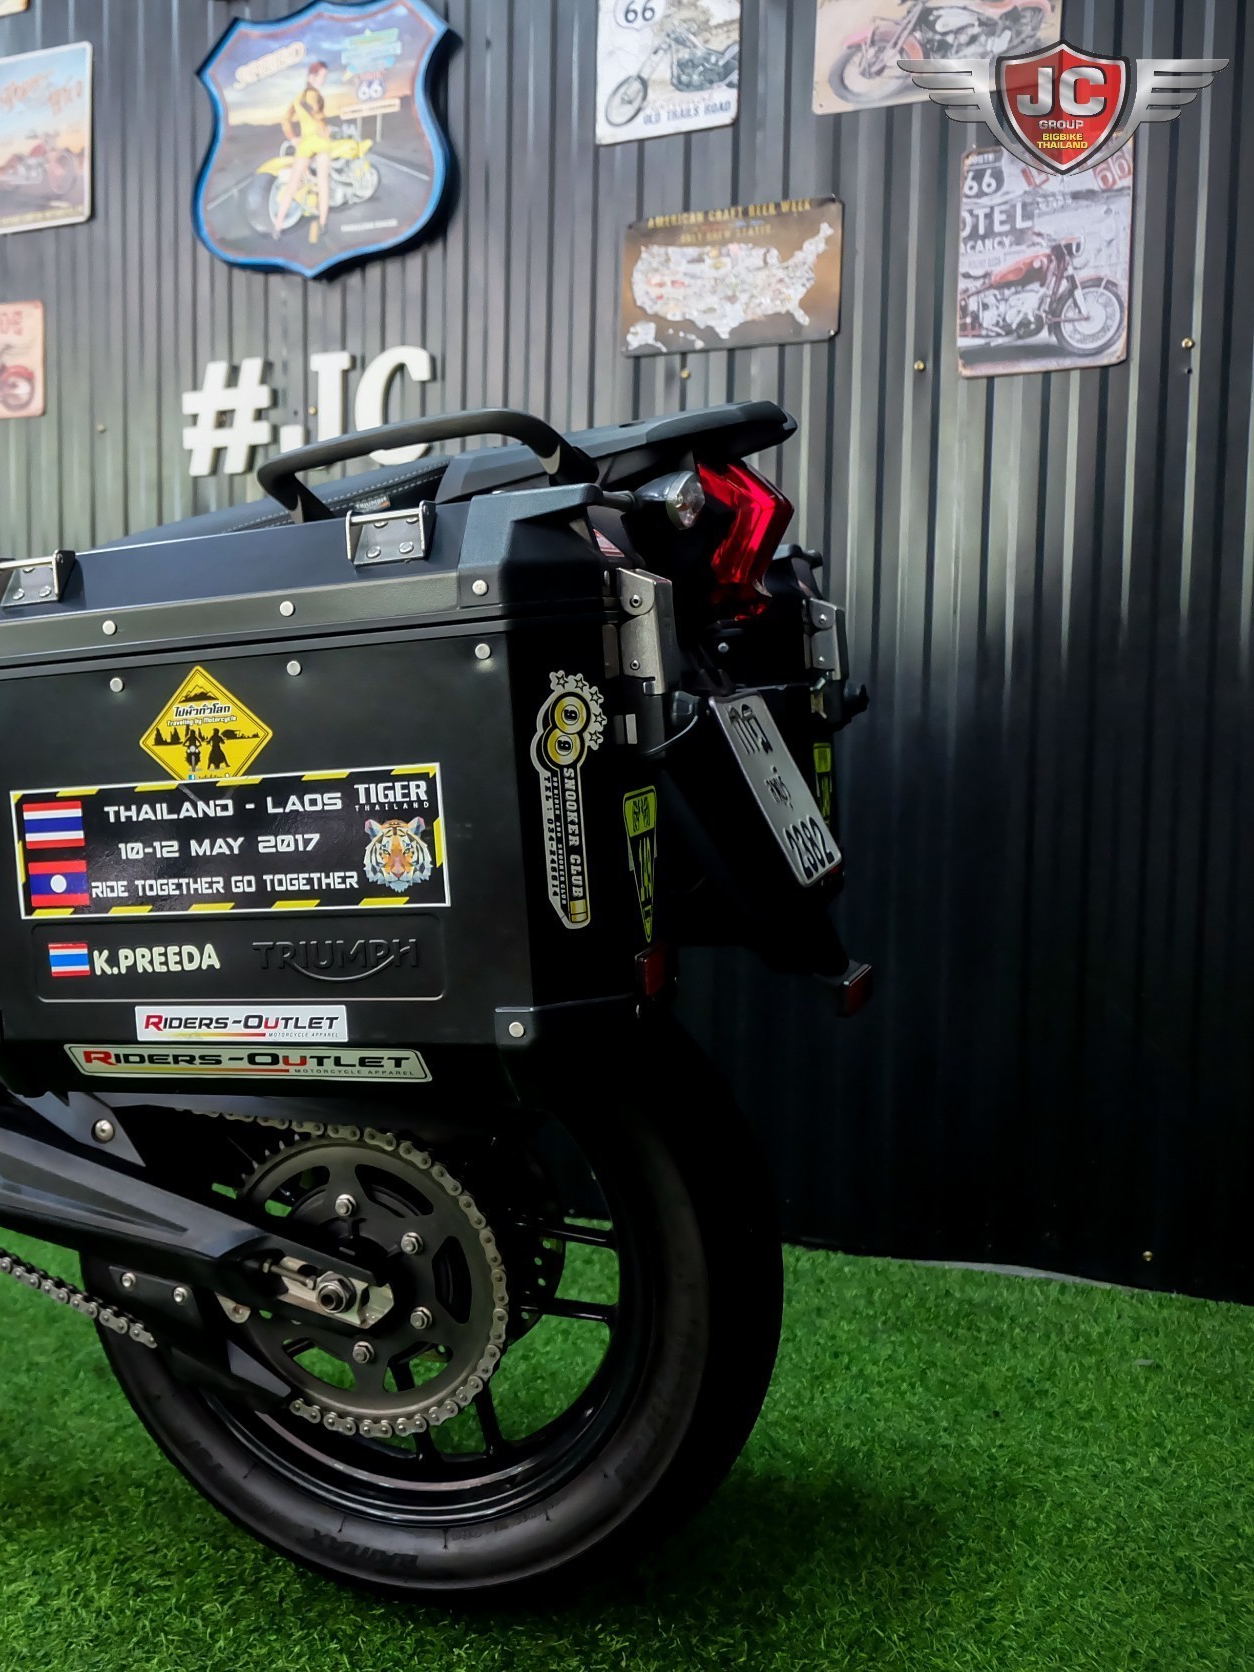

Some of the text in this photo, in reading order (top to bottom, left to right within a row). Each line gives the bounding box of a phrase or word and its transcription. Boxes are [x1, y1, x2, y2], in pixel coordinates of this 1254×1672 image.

[624, 3, 655, 24] 66
[358, 80, 384, 99] 66
[964, 168, 997, 196] 66
[648, 211, 704, 229] AMERICAN
[708, 205, 744, 222] CRAFT
[748, 202, 777, 218] BEER
[780, 198, 811, 213] WEEK
[354, 781, 428, 804] TIGER
[103, 799, 235, 823] THAILAND
[266, 792, 342, 814] LAOS
[354, 801, 429, 812] THAILAND
[118, 833, 321, 860] 10-12 MAY 2017
[563, 768, 584, 898] SNOOKER CLUB
[783, 815, 835, 880] 2382
[91, 871, 359, 898] RIDE TOGETHER GO TOGETHER
[93, 943, 221, 976] K.PREEDA
[252, 938, 419, 972] TRIUMPH
[293, 1067, 415, 1077] MOTORCYCLE APPAREL
